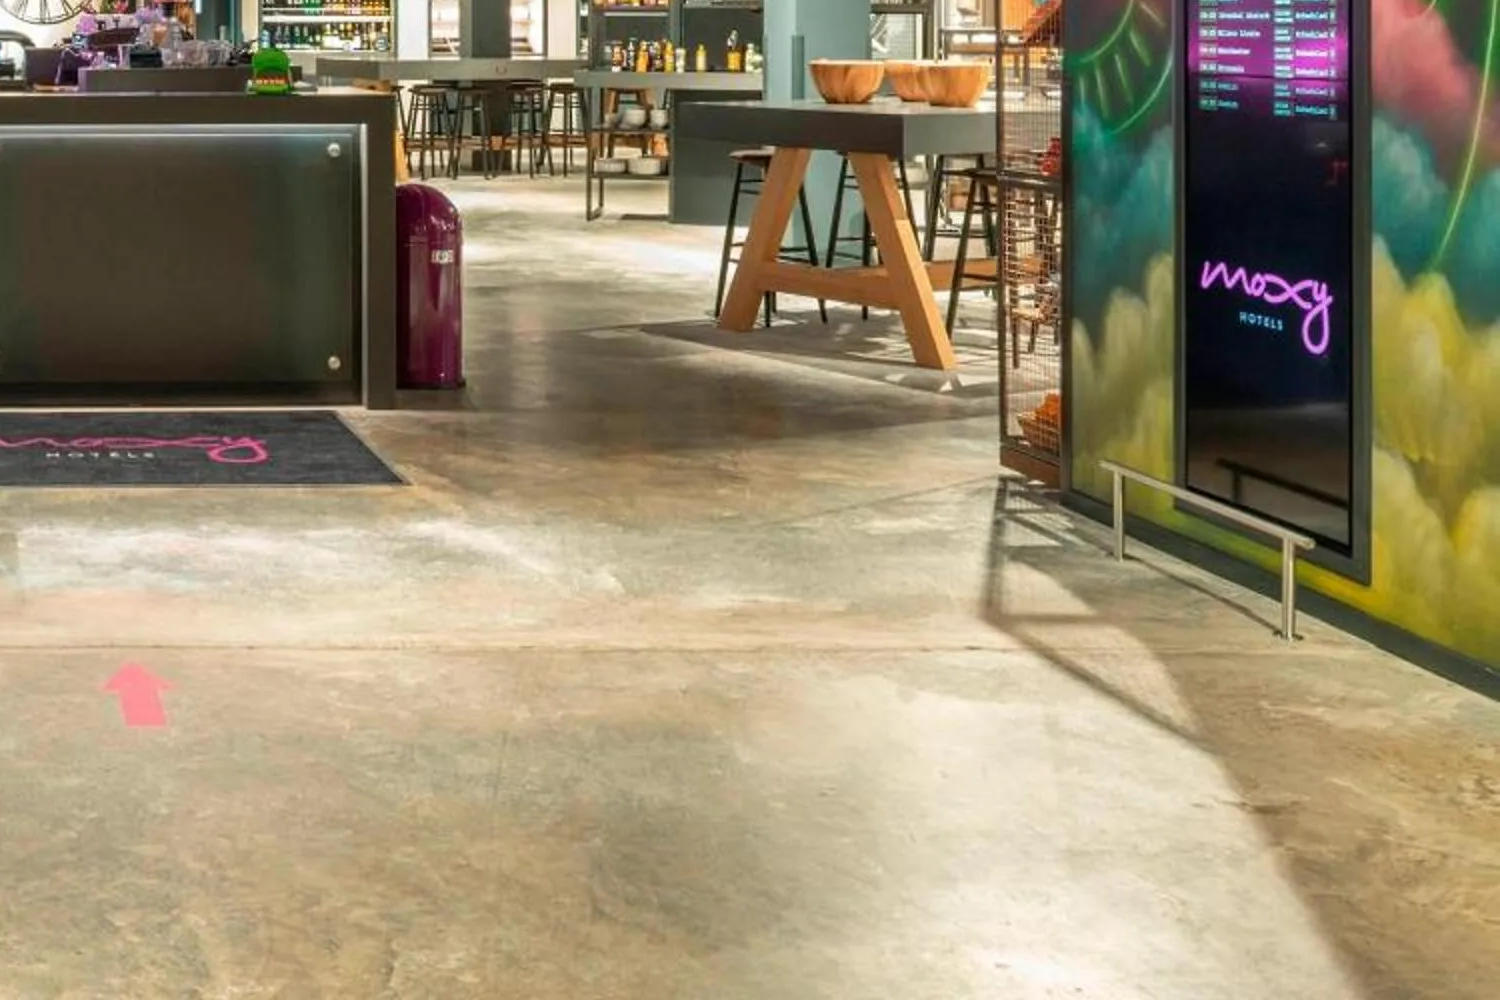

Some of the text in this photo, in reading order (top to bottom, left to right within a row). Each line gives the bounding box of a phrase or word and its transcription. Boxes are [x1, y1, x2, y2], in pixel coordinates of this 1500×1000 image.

[1200, 260, 1334, 355] moxy
[1239, 311, 1283, 331] HOTELS
[45, 451, 154, 459] HOTELS
